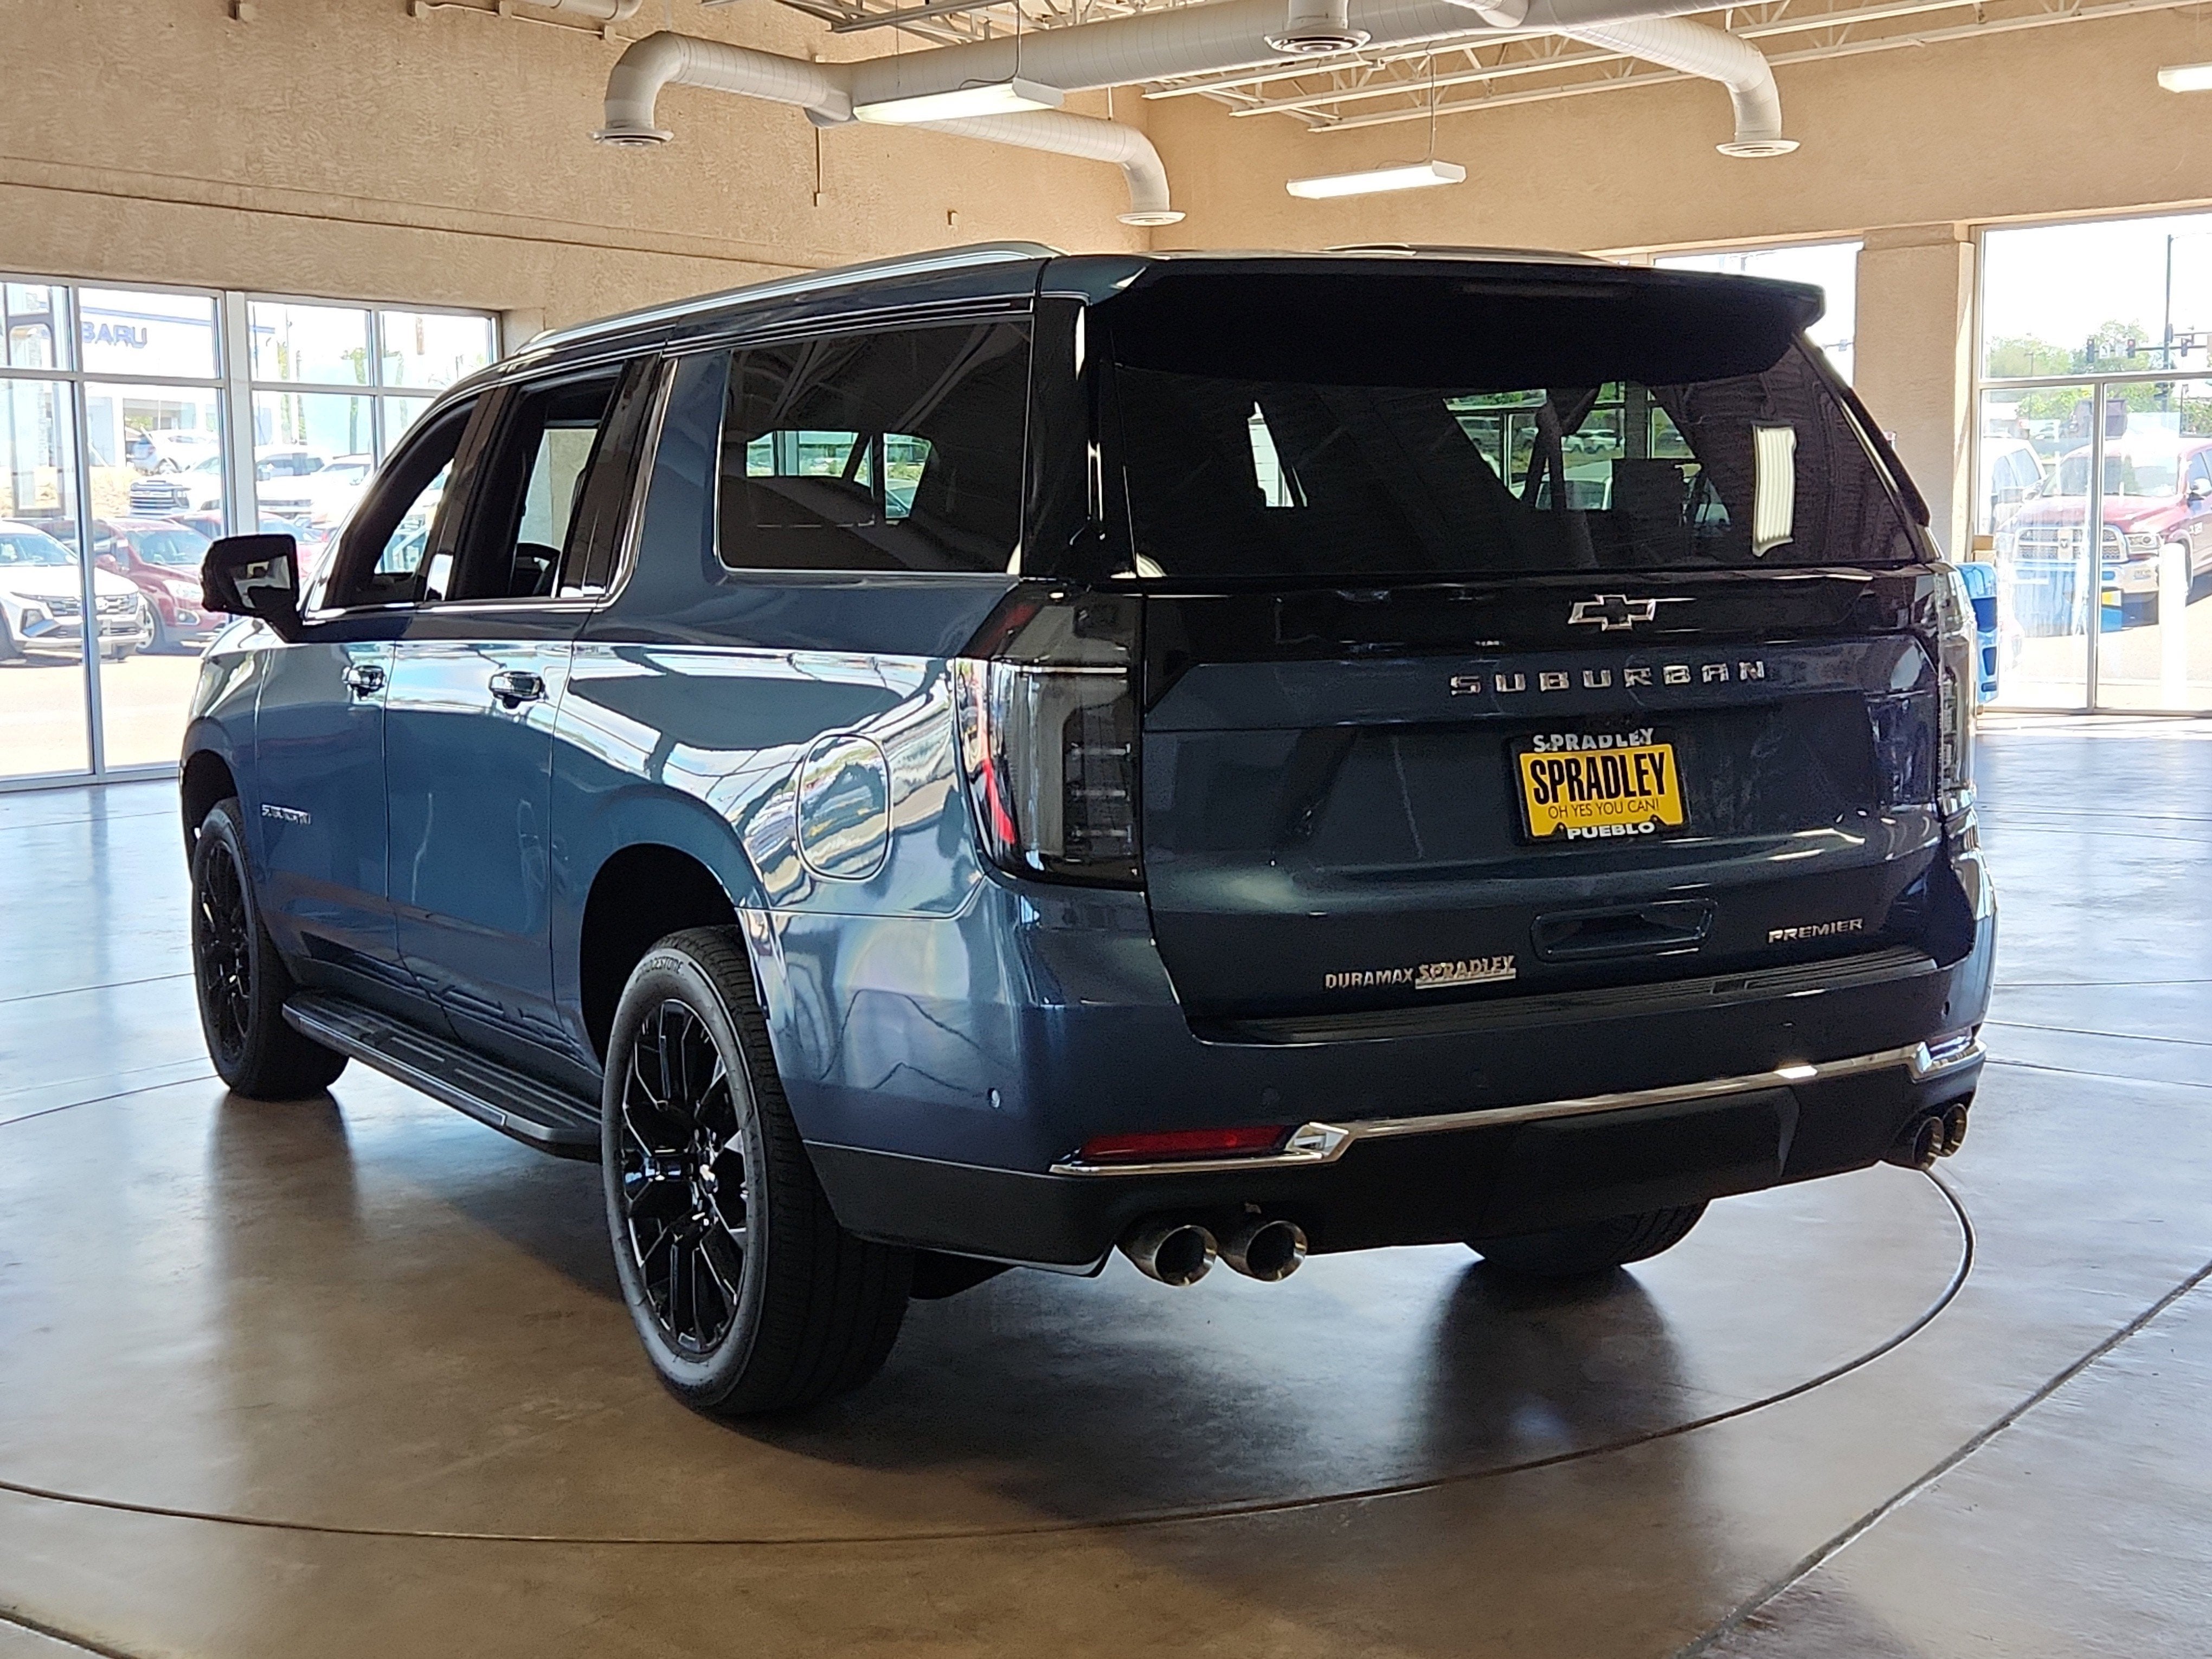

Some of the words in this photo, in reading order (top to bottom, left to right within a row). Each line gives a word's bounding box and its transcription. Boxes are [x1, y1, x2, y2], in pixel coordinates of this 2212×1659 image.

[81, 320, 147, 349] BARU
[1450, 660, 1765, 696] SUBURBAN
[1533, 728, 1654, 753] SPRADLEY
[1529, 751, 1666, 805] SPRADLEY
[1548, 805, 1568, 819] OH
[1571, 803, 1593, 818] YES
[1596, 800, 1624, 815] YOU
[1628, 798, 1660, 813] CAN!
[1567, 821, 1655, 840] PUEBLO
[1768, 918, 1863, 944] PREMIER
[1324, 967, 1414, 989] DURAMAX
[1417, 955, 1516, 981] SPRADLEY
